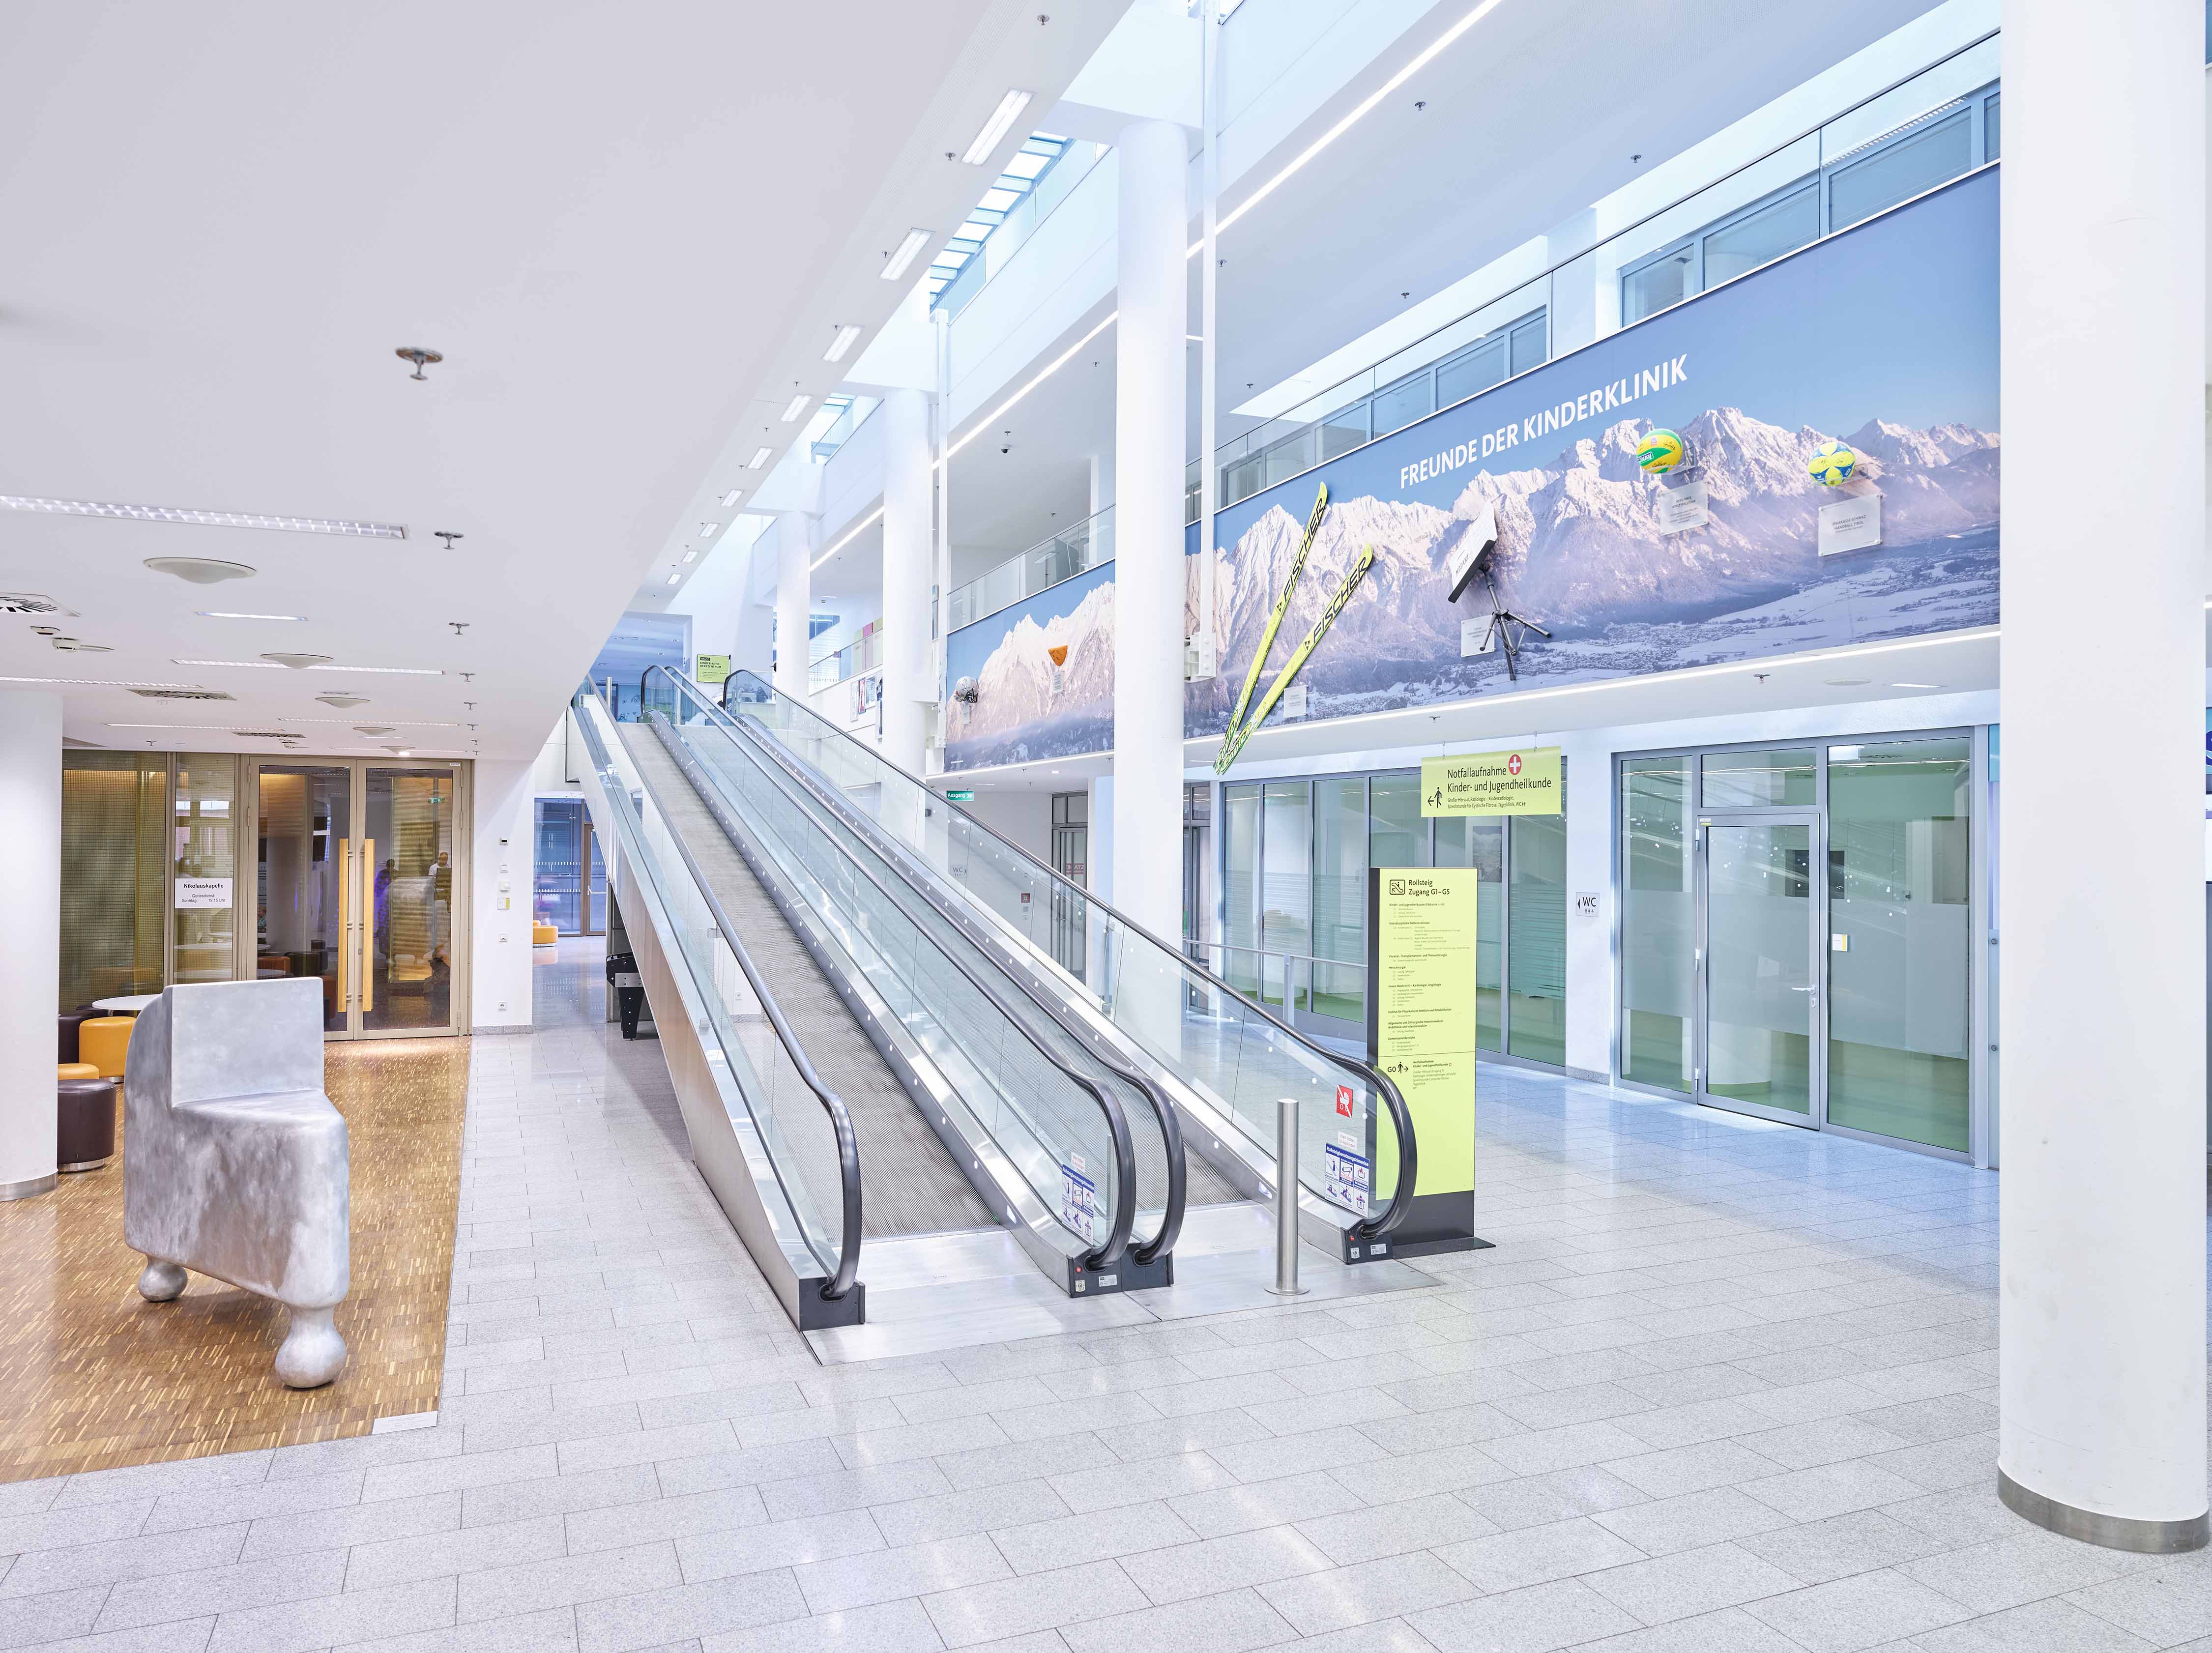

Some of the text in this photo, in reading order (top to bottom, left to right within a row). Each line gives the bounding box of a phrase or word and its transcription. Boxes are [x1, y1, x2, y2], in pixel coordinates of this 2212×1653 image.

[1400, 353, 1688, 489] FREUNDE DER KINDERKLINIK
[1283, 497, 1324, 603] FISCHER
[1313, 556, 1368, 642] FISCHER
[1448, 766, 1507, 779] Notfallaufnahme
[1448, 777, 1552, 793] Kinder- und Jugendheilkunde
[1582, 897, 1597, 907] WC
